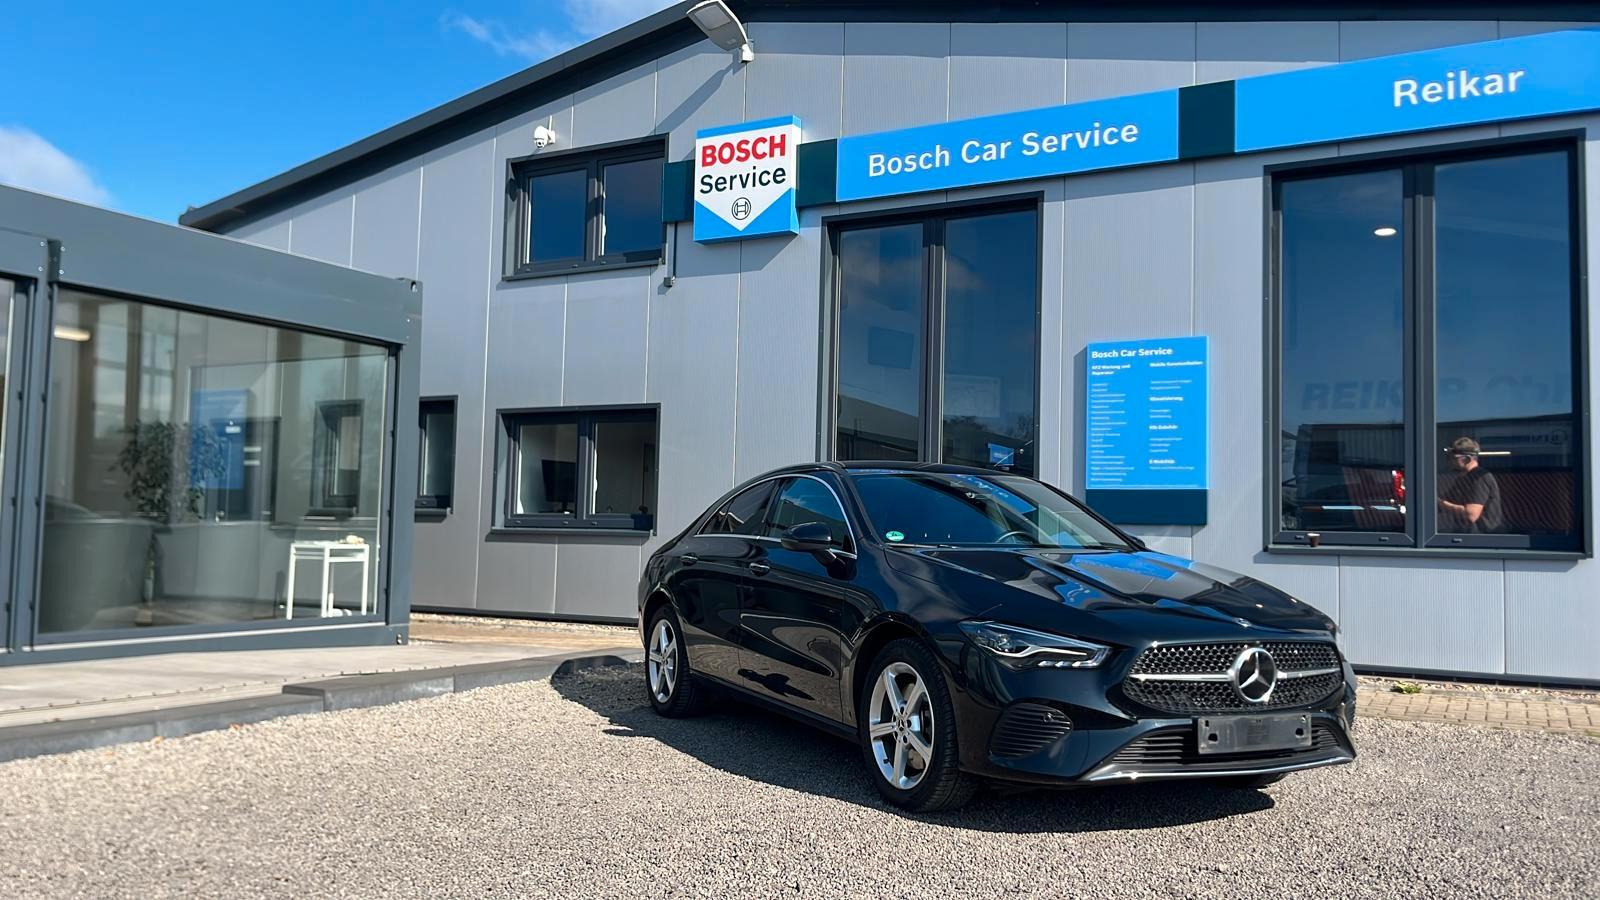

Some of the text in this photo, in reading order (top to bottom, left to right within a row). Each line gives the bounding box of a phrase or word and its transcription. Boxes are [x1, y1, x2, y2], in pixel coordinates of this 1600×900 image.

[1393, 67, 1525, 108] Reikar
[701, 133, 787, 168] BOSCH
[868, 121, 1139, 177] Bosch Car Service
[699, 166, 787, 195] Service
[1091, 347, 1173, 358] Bosch Car Service
